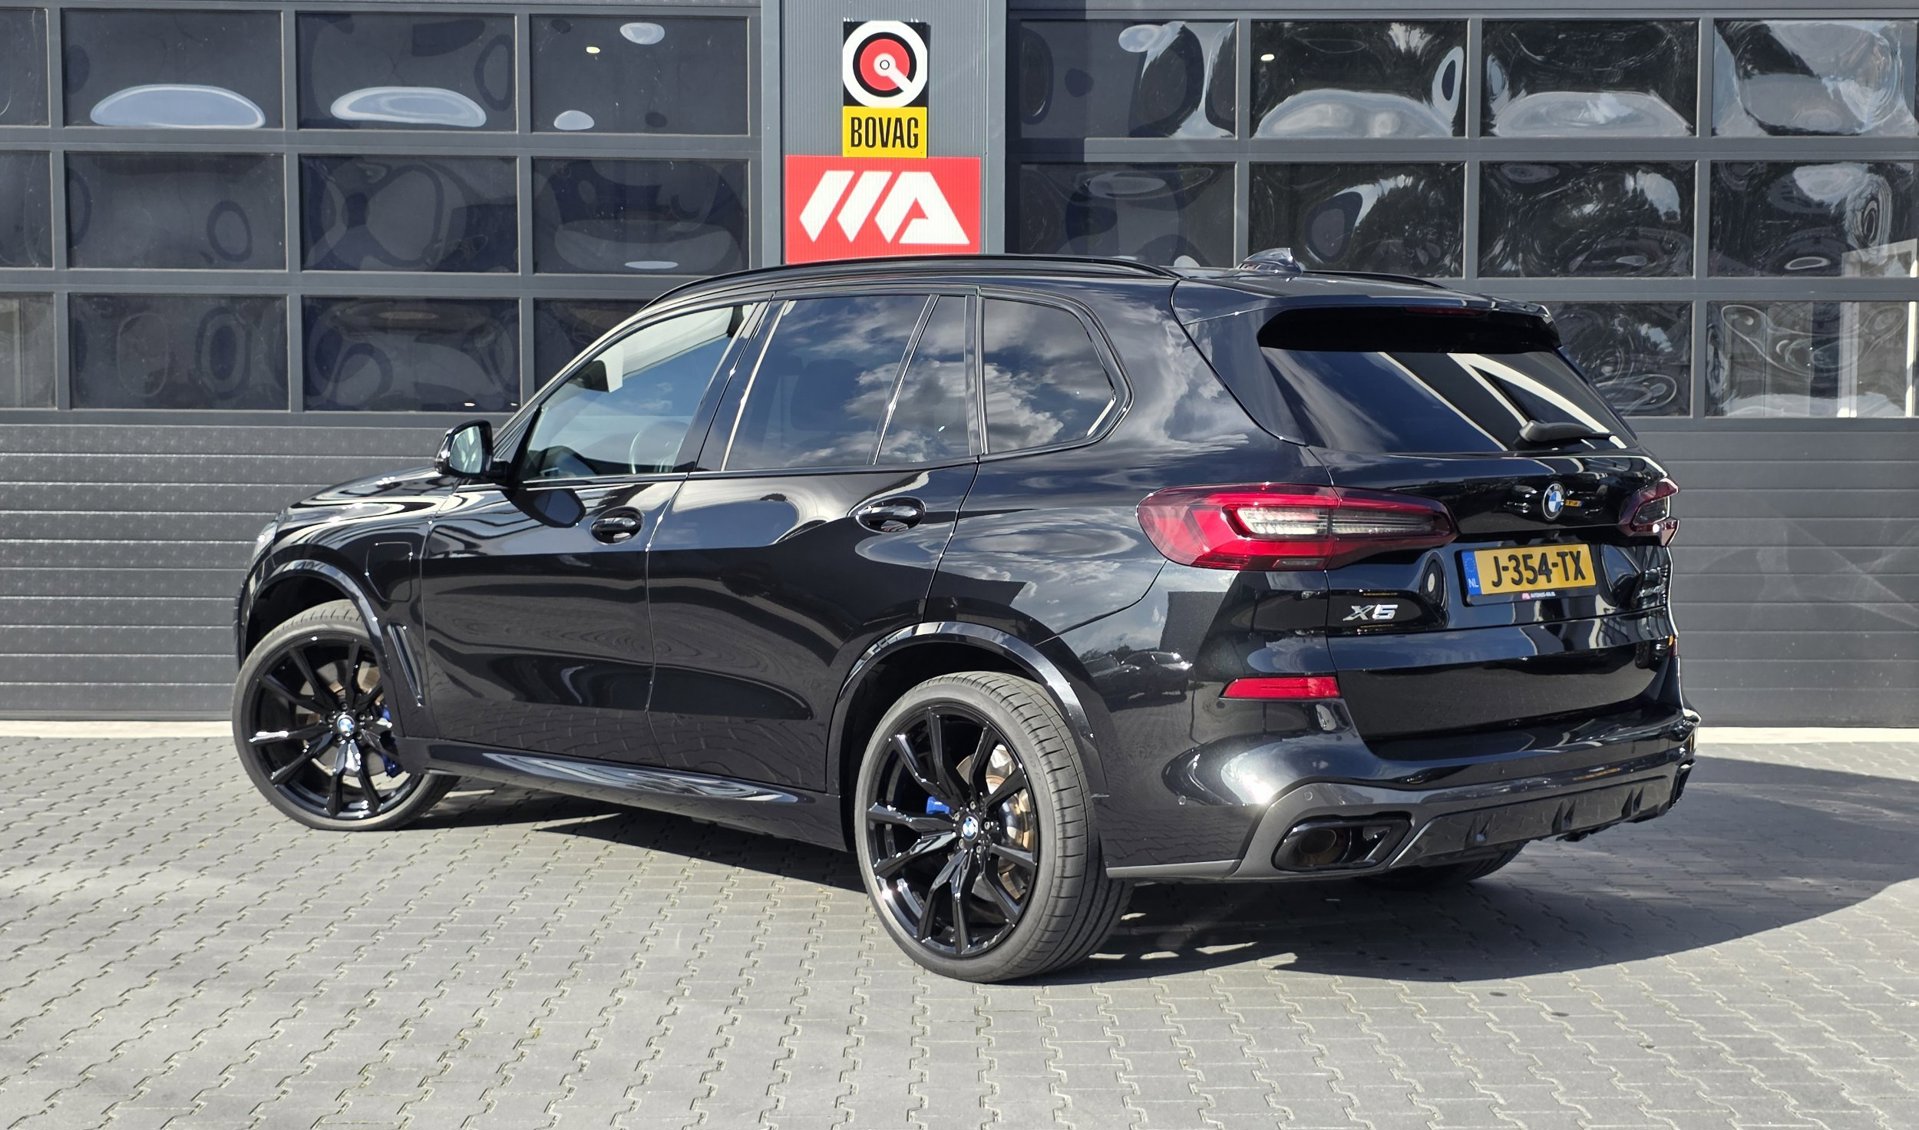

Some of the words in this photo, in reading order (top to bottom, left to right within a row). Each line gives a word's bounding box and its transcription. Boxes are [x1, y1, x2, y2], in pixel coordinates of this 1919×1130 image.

[850, 116, 919, 149] BOVAG
[1491, 550, 1586, 588] J-354-TX
[1468, 578, 1479, 588] NL
[1342, 604, 1399, 621] X5
